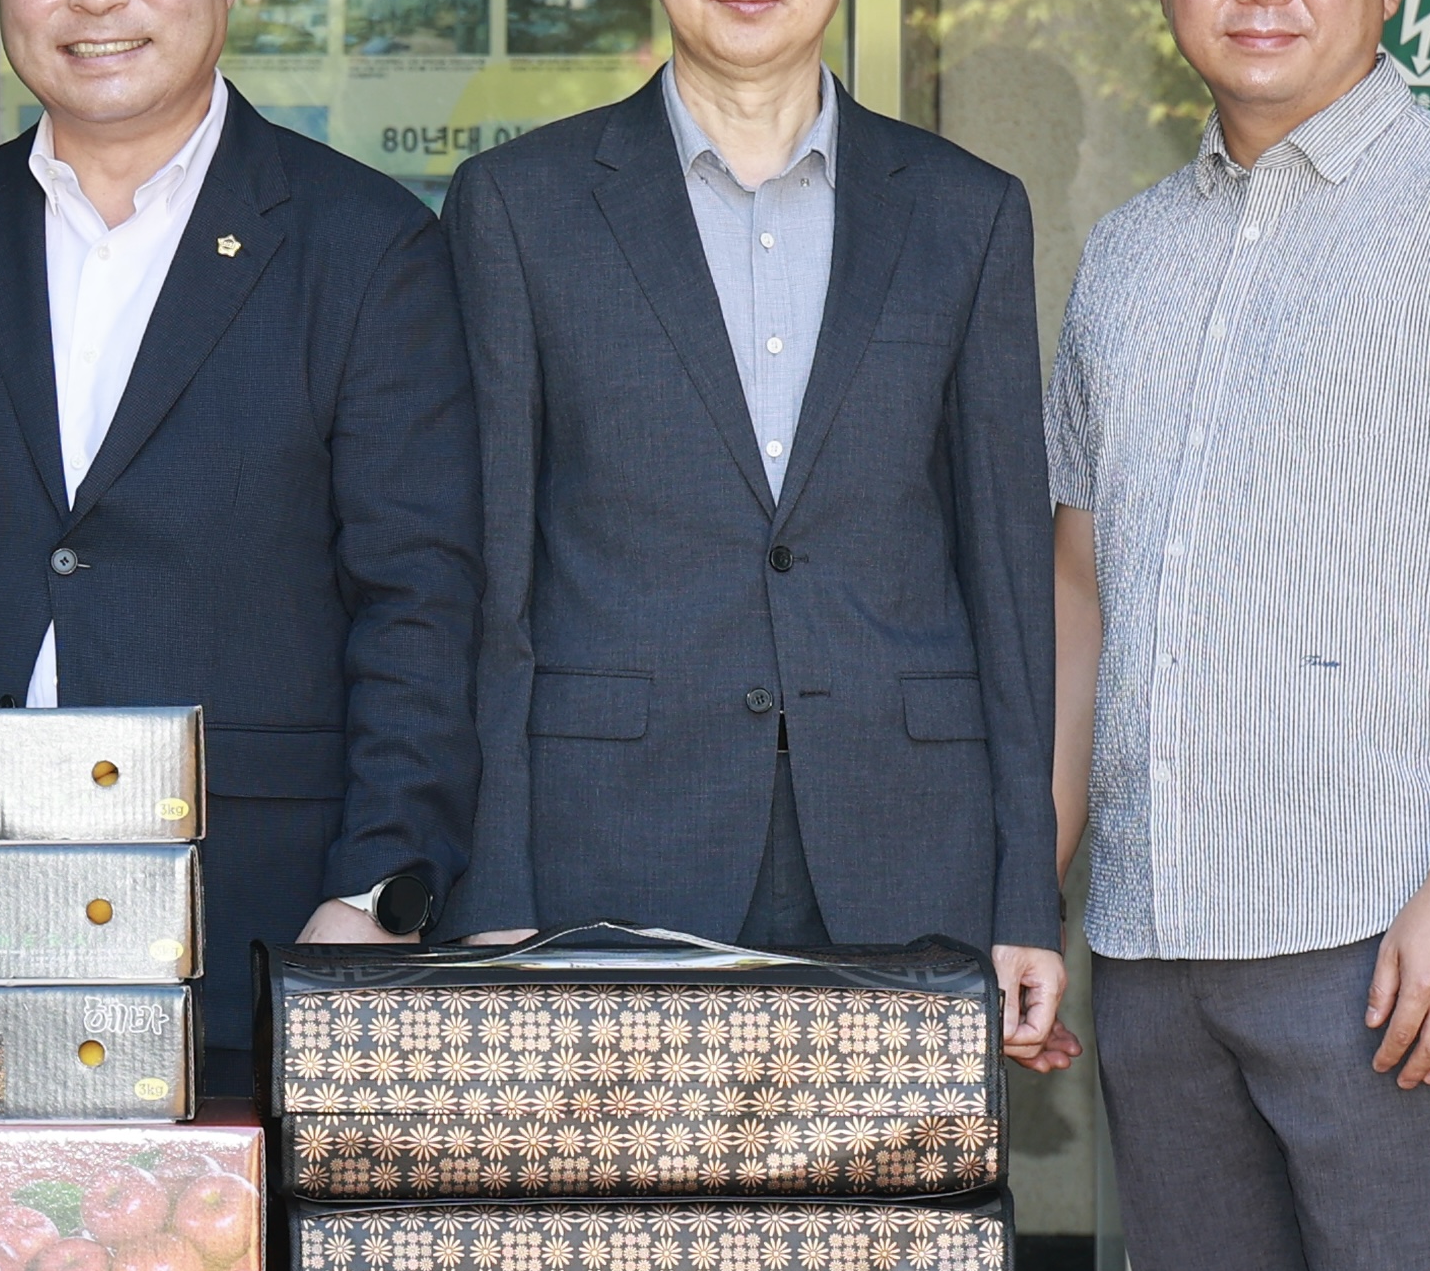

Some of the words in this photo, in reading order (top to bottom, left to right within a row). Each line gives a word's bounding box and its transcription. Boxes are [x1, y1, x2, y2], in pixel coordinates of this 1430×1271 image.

[382, 126, 481, 155] 80년대
[159, 803, 185, 818] 3kg
[138, 1083, 164, 1098] 3kg
